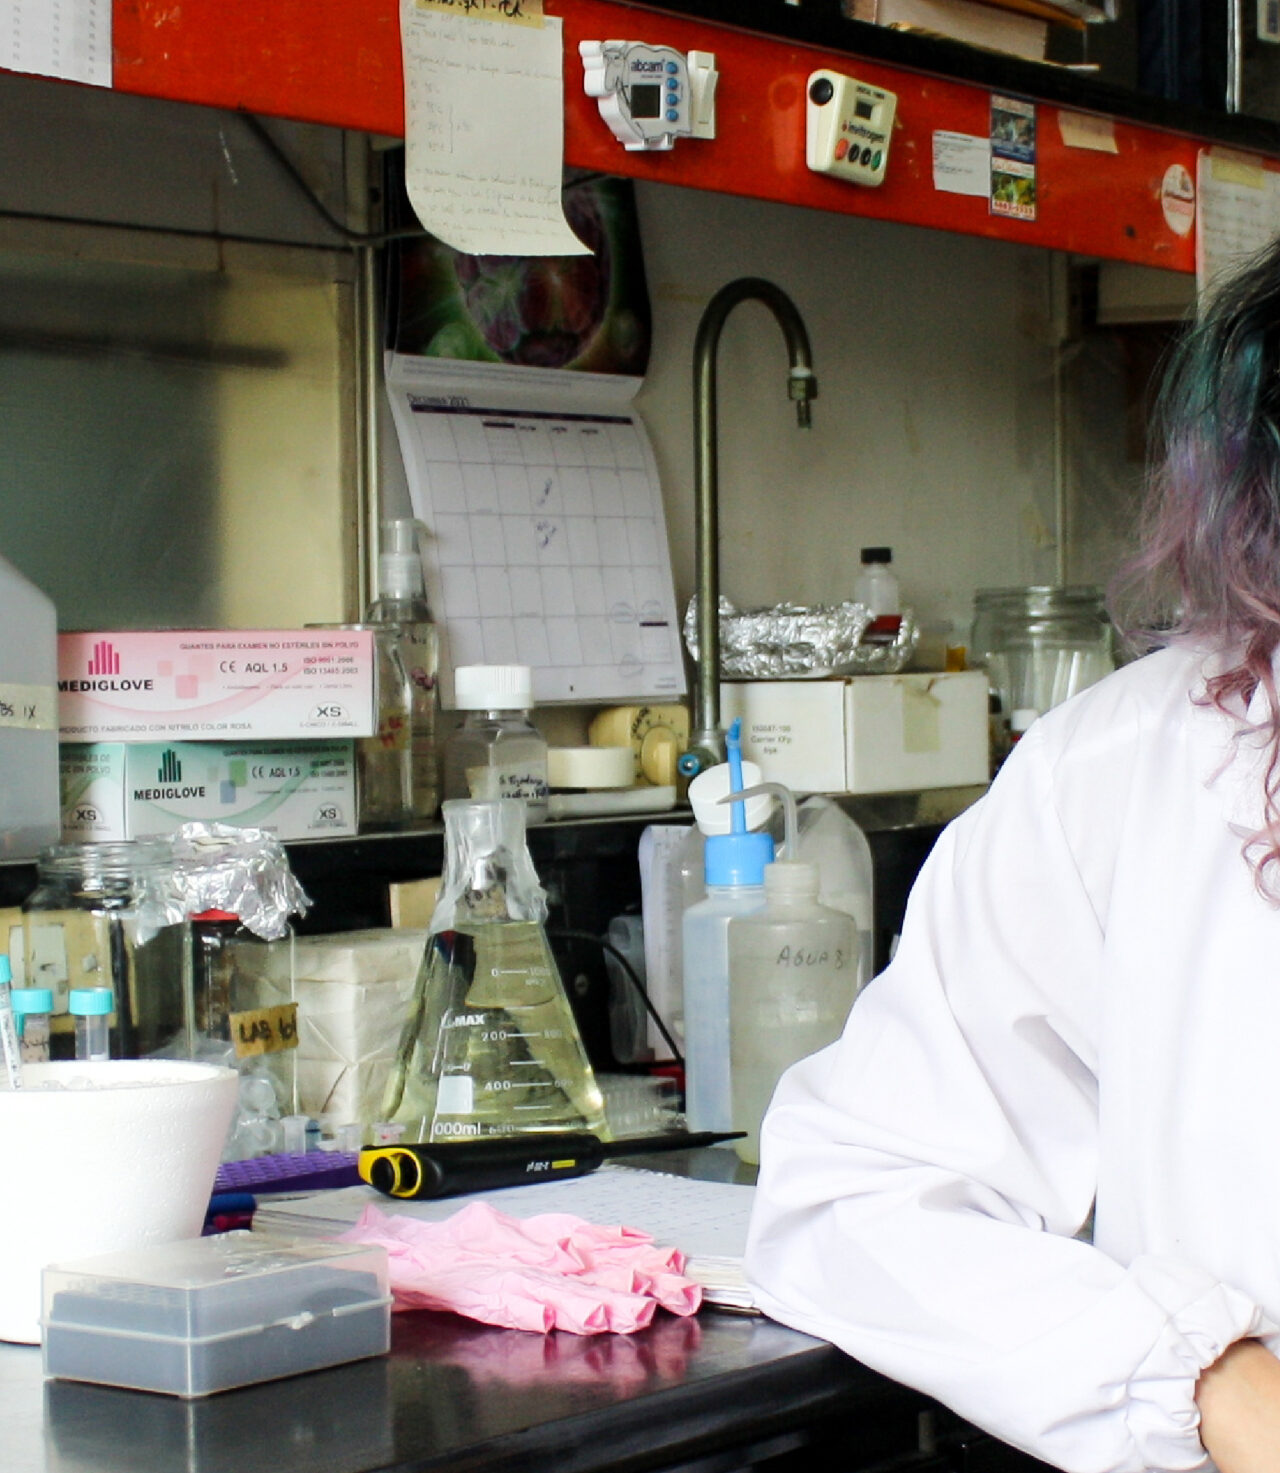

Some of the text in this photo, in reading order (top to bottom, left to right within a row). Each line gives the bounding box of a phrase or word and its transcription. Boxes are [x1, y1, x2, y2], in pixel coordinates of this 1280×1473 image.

[631, 59, 664, 72] abcam
[245, 663, 288, 673] AQL 1.5
[57, 679, 154, 692] MEDIGLOVE
[317, 706, 342, 718] XS
[149, 724, 166, 732] CON
[134, 786, 206, 801] MEDIGLOVE
[76, 810, 97, 821] XS
[319, 808, 337, 819] XS
[454, 1014, 486, 1027] MAX
[239, 1019, 272, 1045] LAB
[482, 1031, 507, 1042] 200
[484, 1080, 512, 1091] 400
